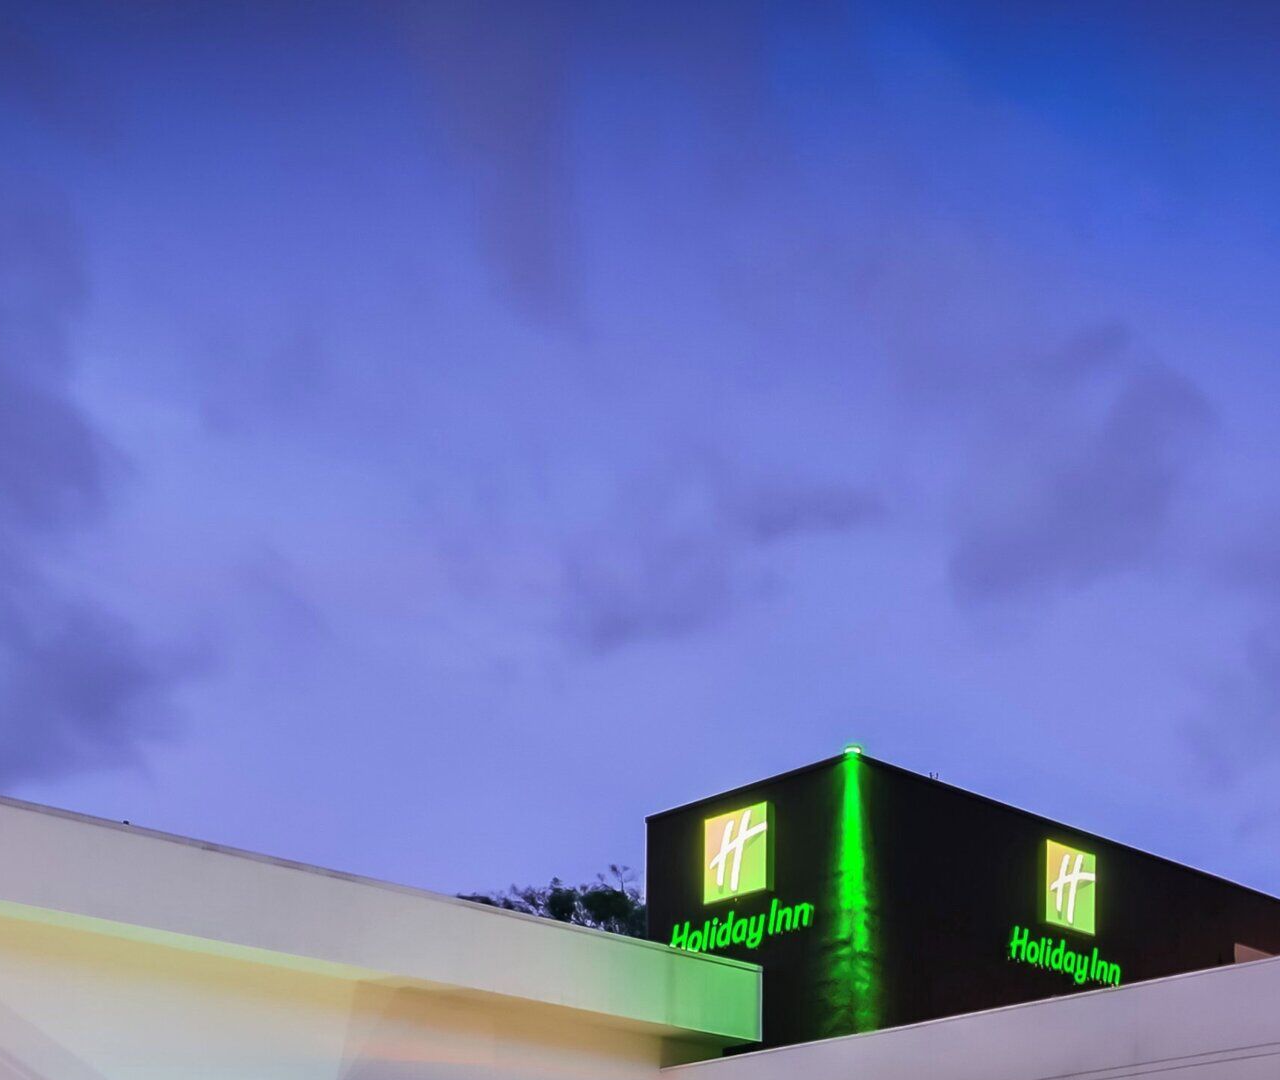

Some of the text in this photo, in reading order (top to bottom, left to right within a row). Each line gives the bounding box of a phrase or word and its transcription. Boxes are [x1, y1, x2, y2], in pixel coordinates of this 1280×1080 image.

[670, 898, 815, 952] Holiday Inn
[1010, 925, 1121, 987] Holiday Inn
